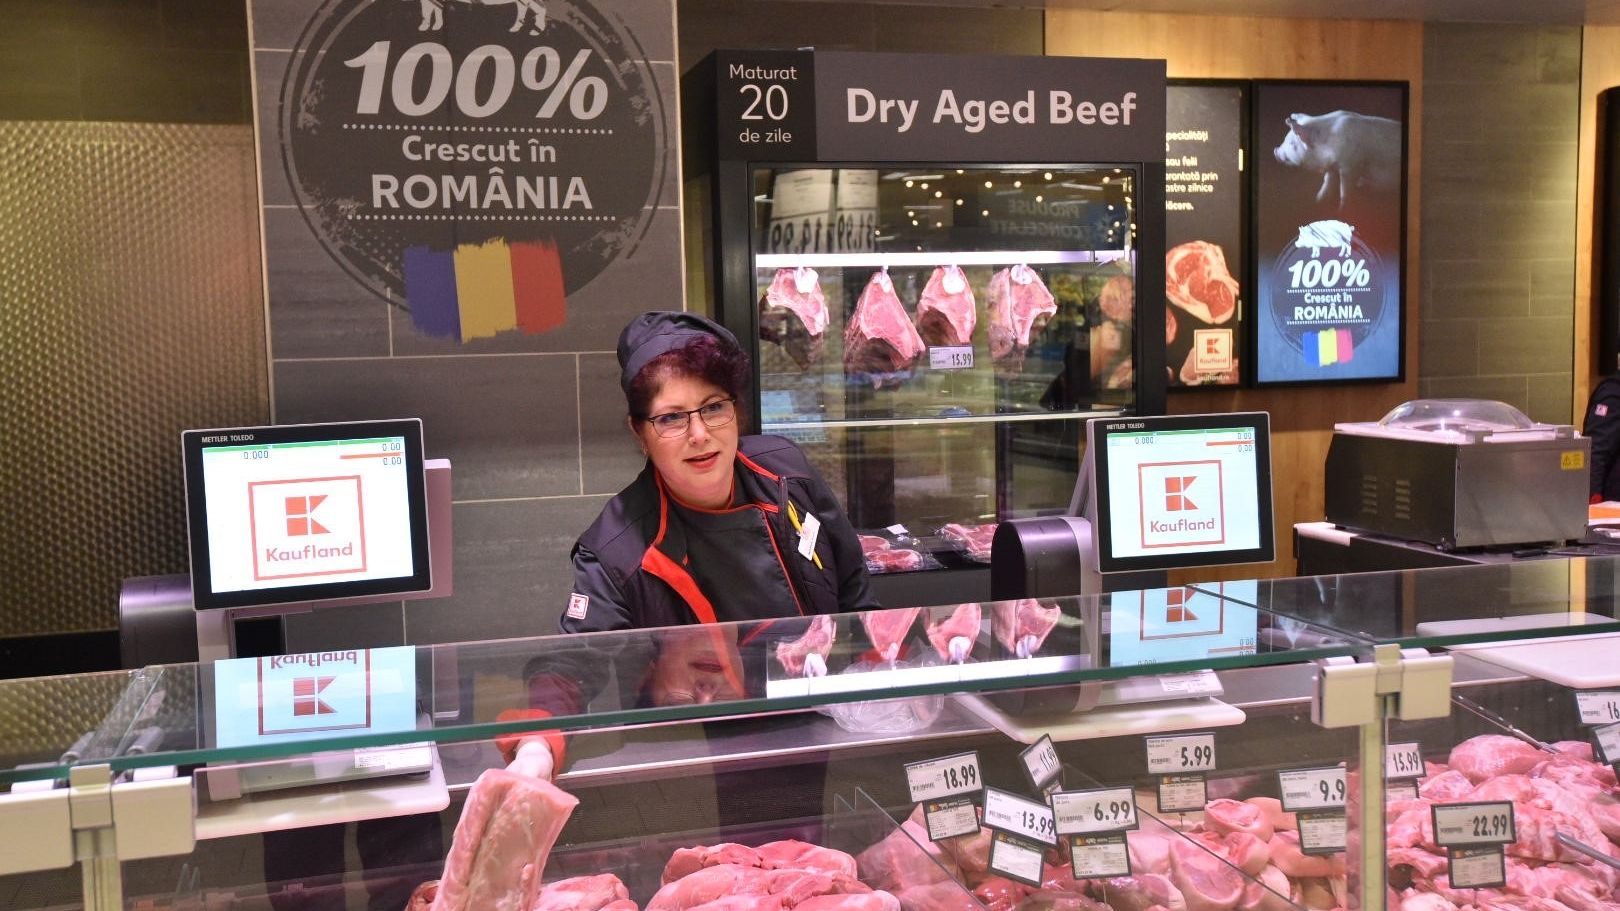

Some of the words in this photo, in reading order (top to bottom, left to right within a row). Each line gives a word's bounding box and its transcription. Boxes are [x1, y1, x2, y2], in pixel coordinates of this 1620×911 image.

[343, 40, 609, 120] 100%
[729, 63, 797, 81] Maturat
[738, 84, 789, 121] 20
[847, 87, 919, 133] Dry
[932, 89, 1036, 133] Aged
[1049, 90, 1137, 126] Beef
[739, 129, 761, 144] de
[766, 128, 792, 144] zile
[402, 135, 520, 163] Crescut
[529, 138, 557, 163] în
[1182, 155, 1198, 167] felii
[371, 166, 593, 210] ROMÂNIA
[1187, 183, 1214, 193] zilnice
[1201, 172, 1218, 183] prin
[1288, 259, 1370, 288] 100%
[1304, 293, 1341, 304] Crescut
[1343, 292, 1353, 304] în
[1294, 304, 1364, 320] ROMÂNIA
[952, 353, 971, 367] 15.99
[201, 435, 228, 444] METTLER
[230, 433, 254, 442] TOLEDO
[382, 442, 401, 452] 0.00
[383, 457, 402, 467] 0.00
[1150, 518, 1215, 533] Kaufland
[266, 542, 353, 563] Kaufland
[1181, 745, 1212, 767] 5.99
[1393, 752, 1419, 773] 15.99
[943, 763, 976, 790] 18.99
[1094, 801, 1131, 822] 6.99
[1022, 810, 1055, 835] 13.99
[1473, 814, 1508, 837] 22.99
